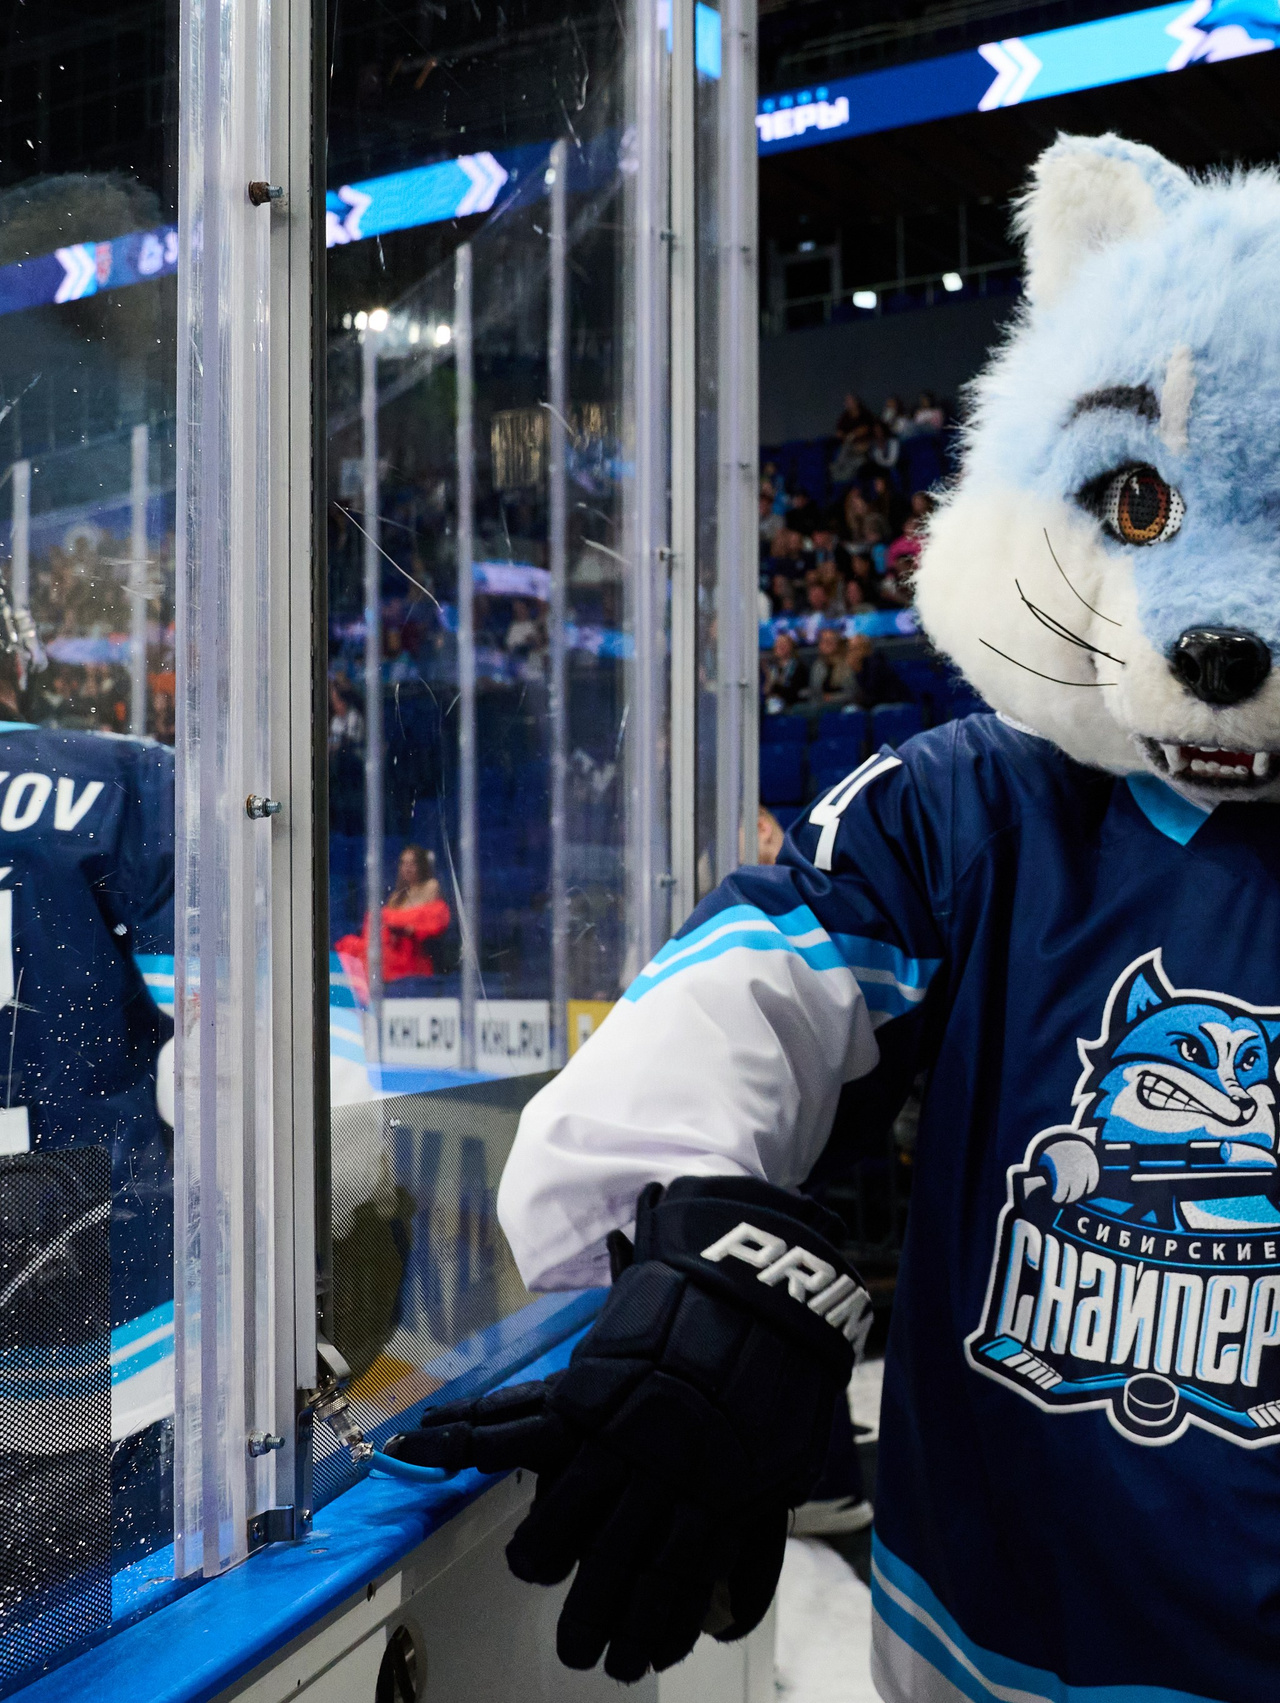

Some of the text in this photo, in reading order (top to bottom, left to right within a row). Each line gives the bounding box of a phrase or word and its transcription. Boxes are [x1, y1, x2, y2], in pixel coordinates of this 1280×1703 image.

[0, 771, 105, 832] OV
[388, 1013, 457, 1050] KHL.RU
[481, 1018, 547, 1058] KHL.RU
[1076, 1215, 1278, 1261] СИБИРСКИЕ
